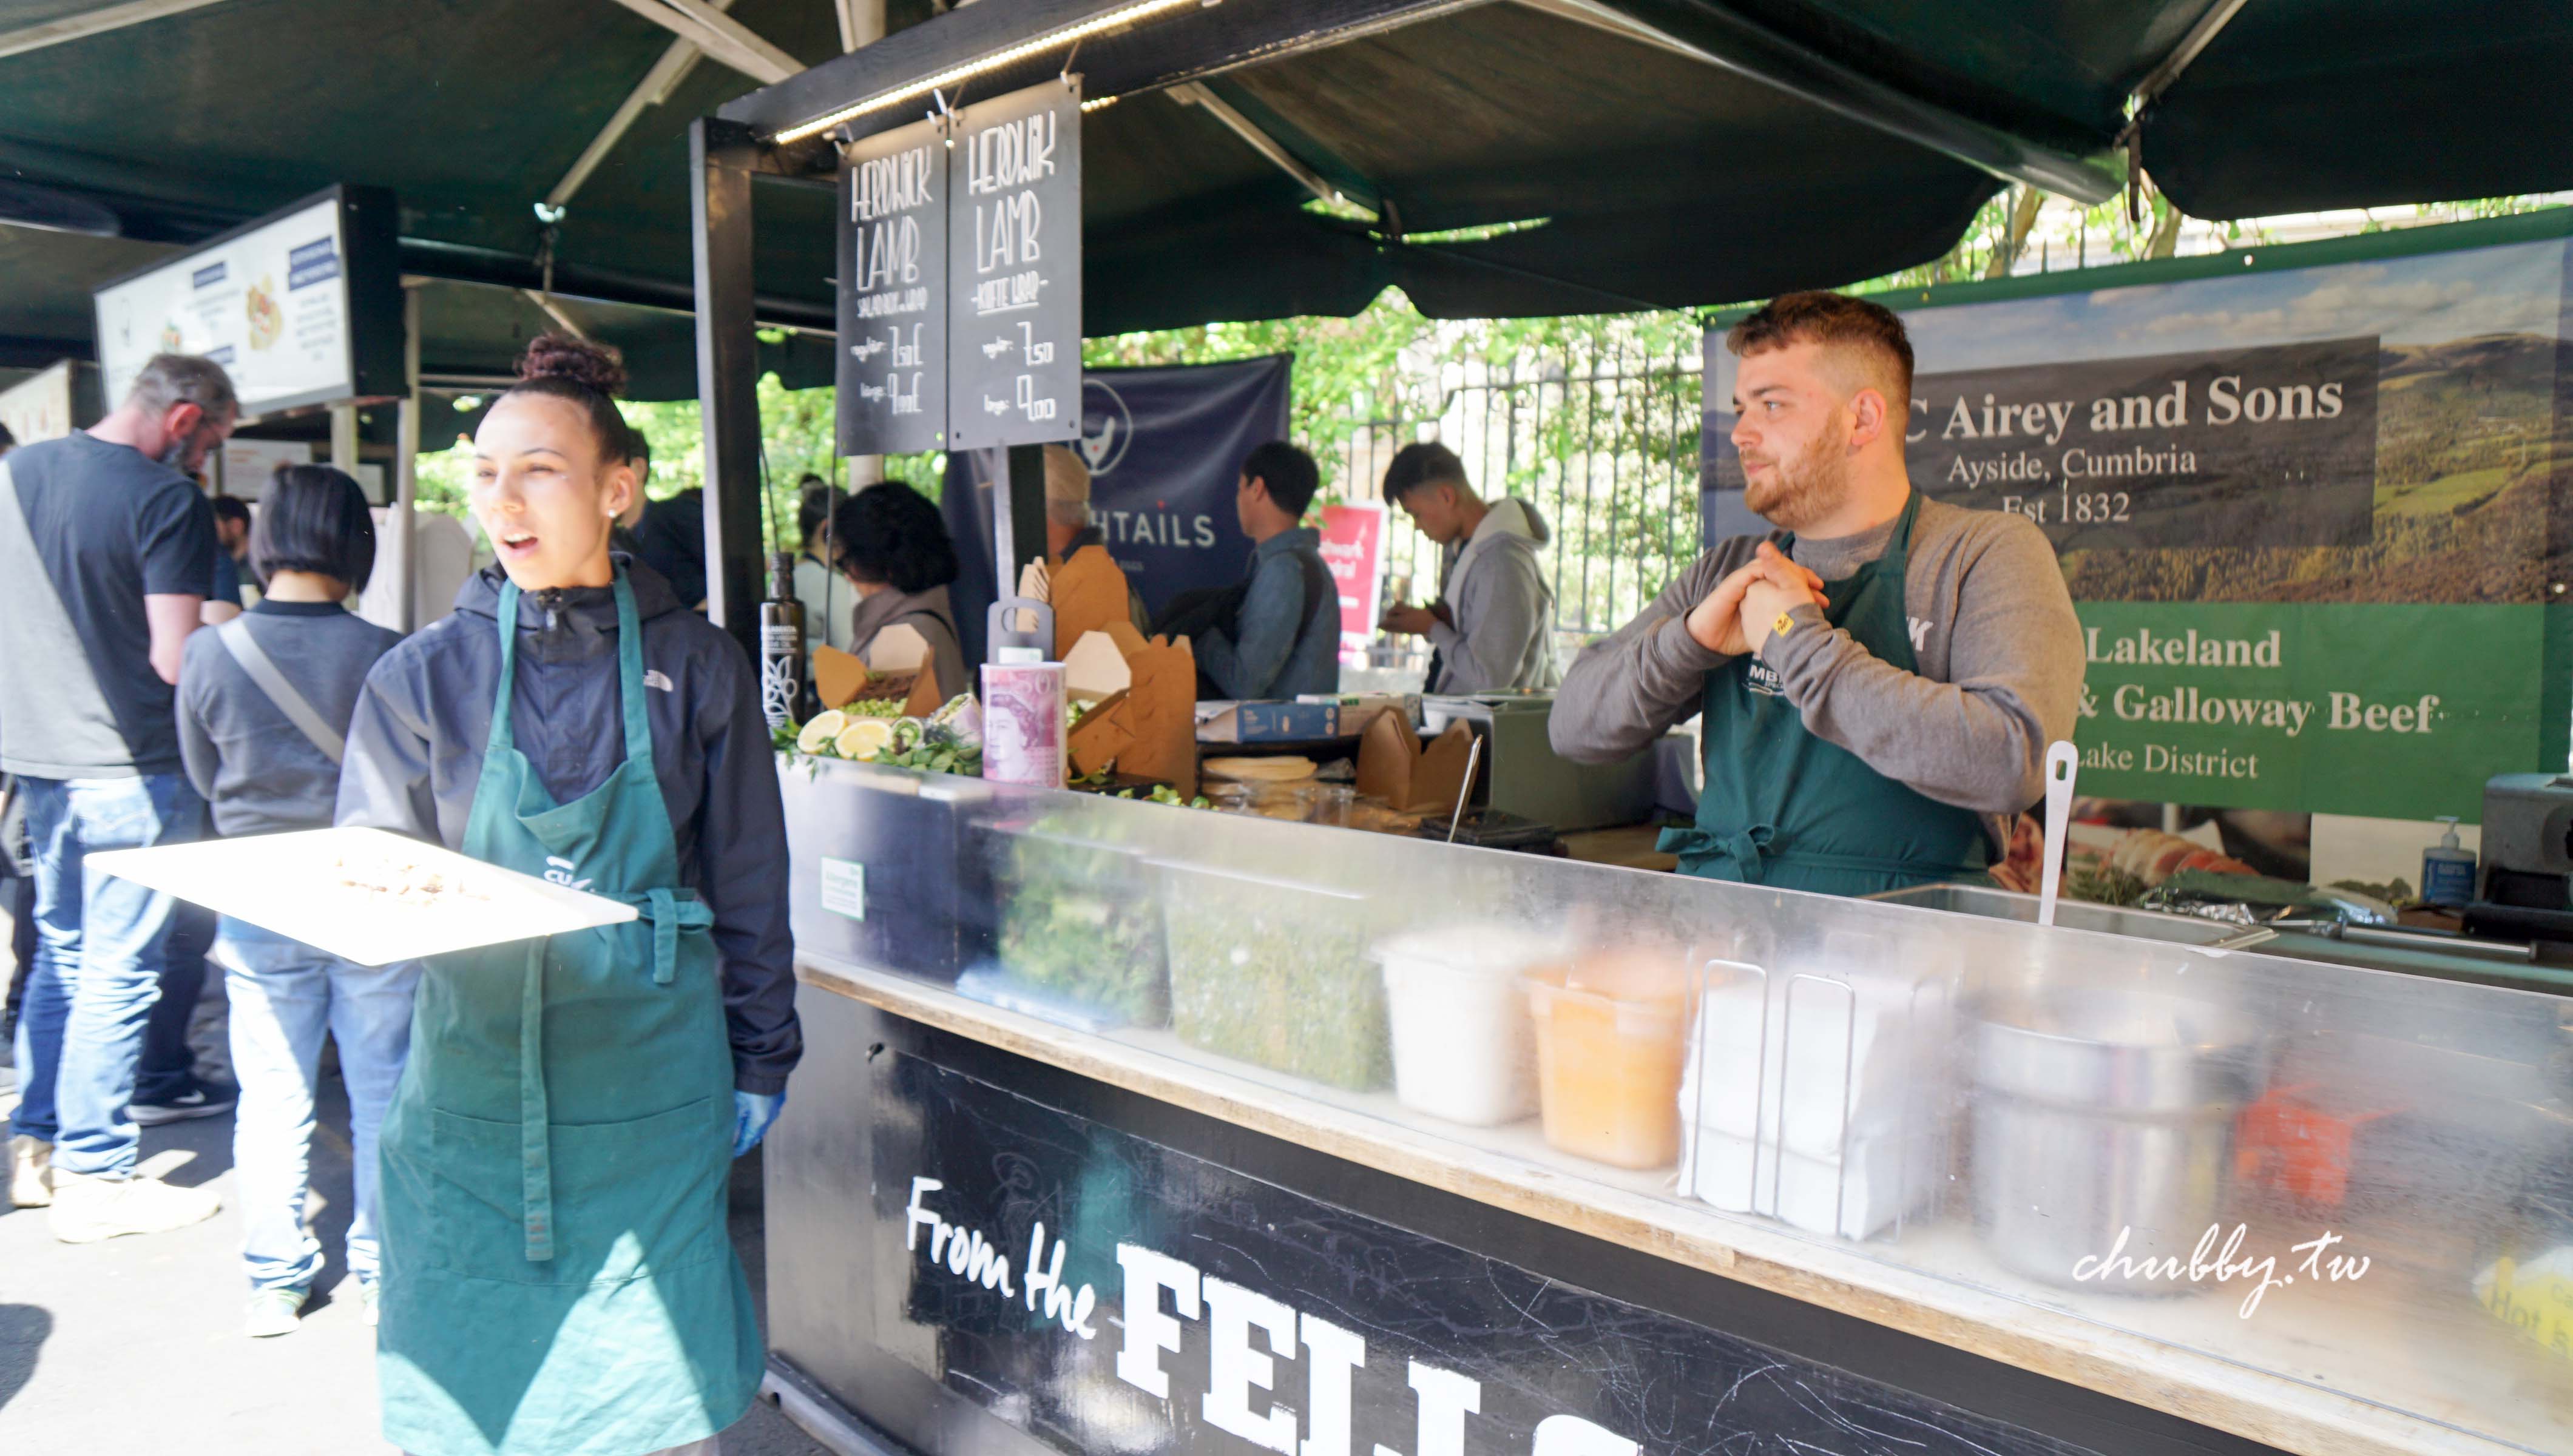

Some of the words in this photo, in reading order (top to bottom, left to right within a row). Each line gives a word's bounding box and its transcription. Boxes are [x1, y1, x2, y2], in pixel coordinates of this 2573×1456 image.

[856, 215, 921, 291] LAMB
[976, 189, 1041, 273] LAMB
[1942, 393, 2075, 446] Airey
[2090, 380, 2188, 433] and
[2206, 374, 2344, 427] Sons
[1947, 451, 2052, 489] Ayside,
[2061, 443, 2197, 478] Cumbria
[1090, 510, 1216, 548] HTAILS
[2003, 494, 2047, 524] Est
[2060, 491, 2131, 523] 1832
[2086, 626, 2282, 667] Lakeland
[2078, 682, 2100, 719] &
[2113, 684, 2313, 736] Galloway
[2327, 691, 2440, 734] Beef
[2078, 741, 2134, 770] ake
[2145, 743, 2259, 779] District
[907, 1175, 1015, 1298] From
[1024, 1221, 1097, 1340] the
[1117, 1242, 1643, 1456] FELL
